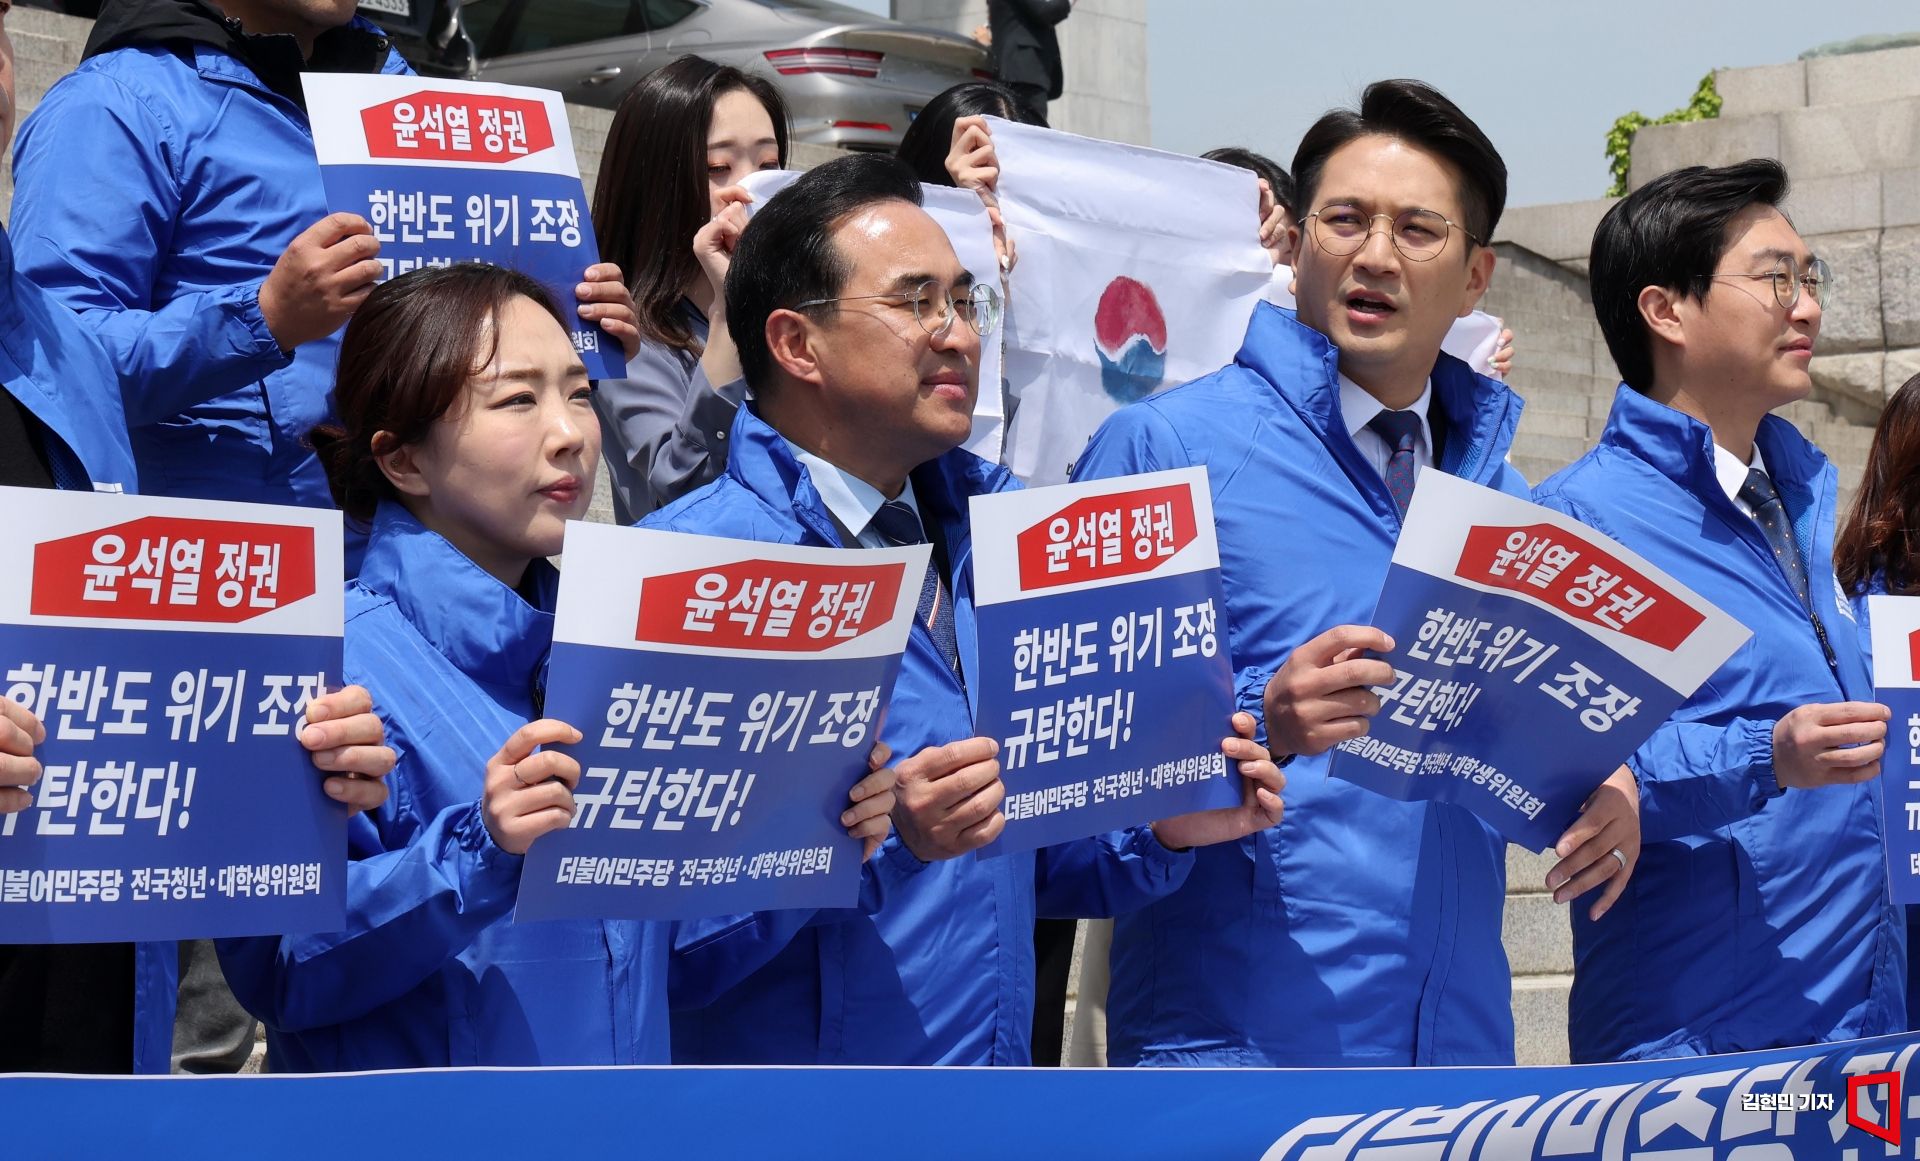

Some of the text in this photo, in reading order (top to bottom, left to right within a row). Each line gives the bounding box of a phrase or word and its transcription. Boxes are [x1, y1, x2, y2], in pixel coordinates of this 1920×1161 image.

[392, 102, 529, 154] 윤석열 정권
[368, 190, 582, 248] 한반도 위기 조장
[83, 534, 280, 609] 윤석열 정권
[1046, 501, 1175, 574] 윤석열 정권
[682, 573, 875, 639] 윤석열 정권
[1488, 530, 1657, 631] 윤석열 정권
[1013, 597, 1218, 692] 한반도 위기 조장
[1407, 607, 1643, 735] 한반도 위기 조장
[165, 669, 246, 742] 위기
[599, 682, 881, 754] 한반도 위기 조장
[1004, 688, 1136, 770] 규탄한다!
[568, 766, 756, 832] 규탄한다!
[1004, 751, 1228, 821] 더불어민주당 전국청년·대학생위원회
[0, 862, 322, 903] 불어민주당 전국청년·대학생위원회
[556, 846, 834, 887] 더불어민주당 전국청년·대학생위원회
